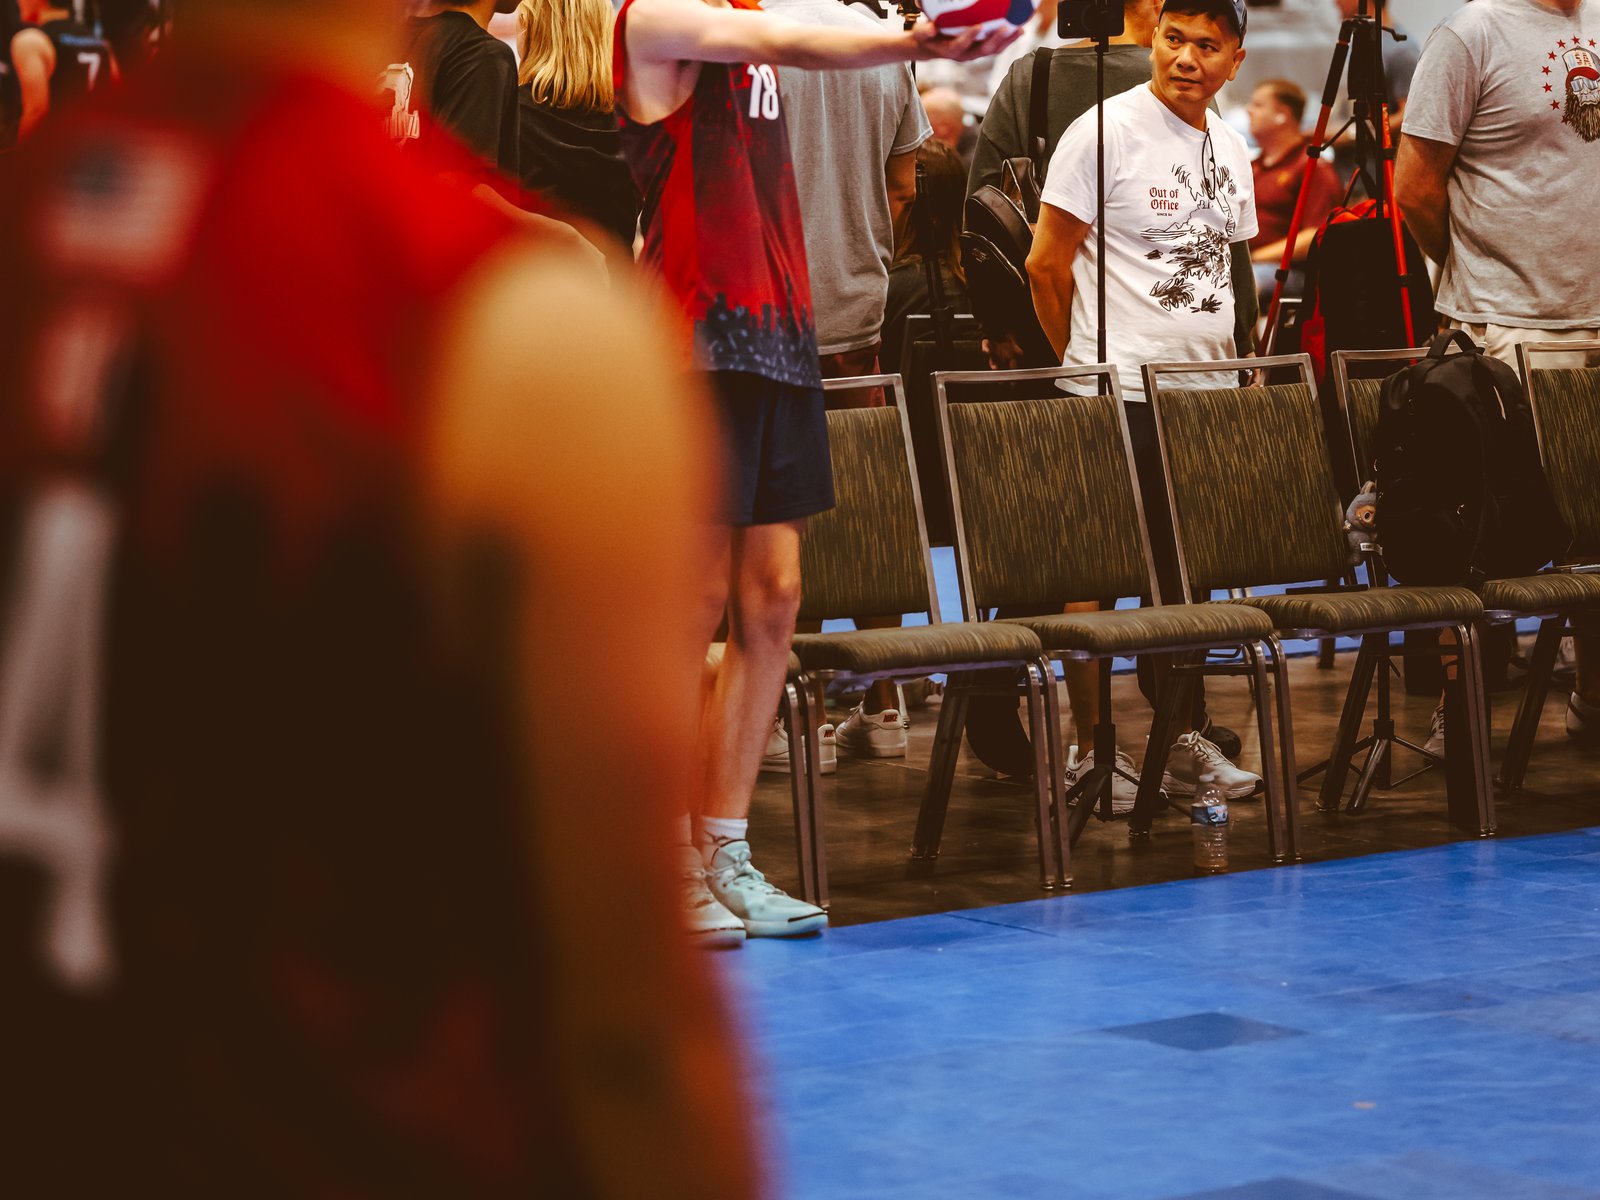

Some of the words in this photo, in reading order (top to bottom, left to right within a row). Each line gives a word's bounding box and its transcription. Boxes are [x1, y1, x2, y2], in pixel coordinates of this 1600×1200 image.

[77, 52, 100, 92] 7
[747, 63, 780, 120] 18
[1149, 187, 1167, 198] Out
[1169, 188, 1179, 199] of
[1150, 199, 1179, 210] Office
